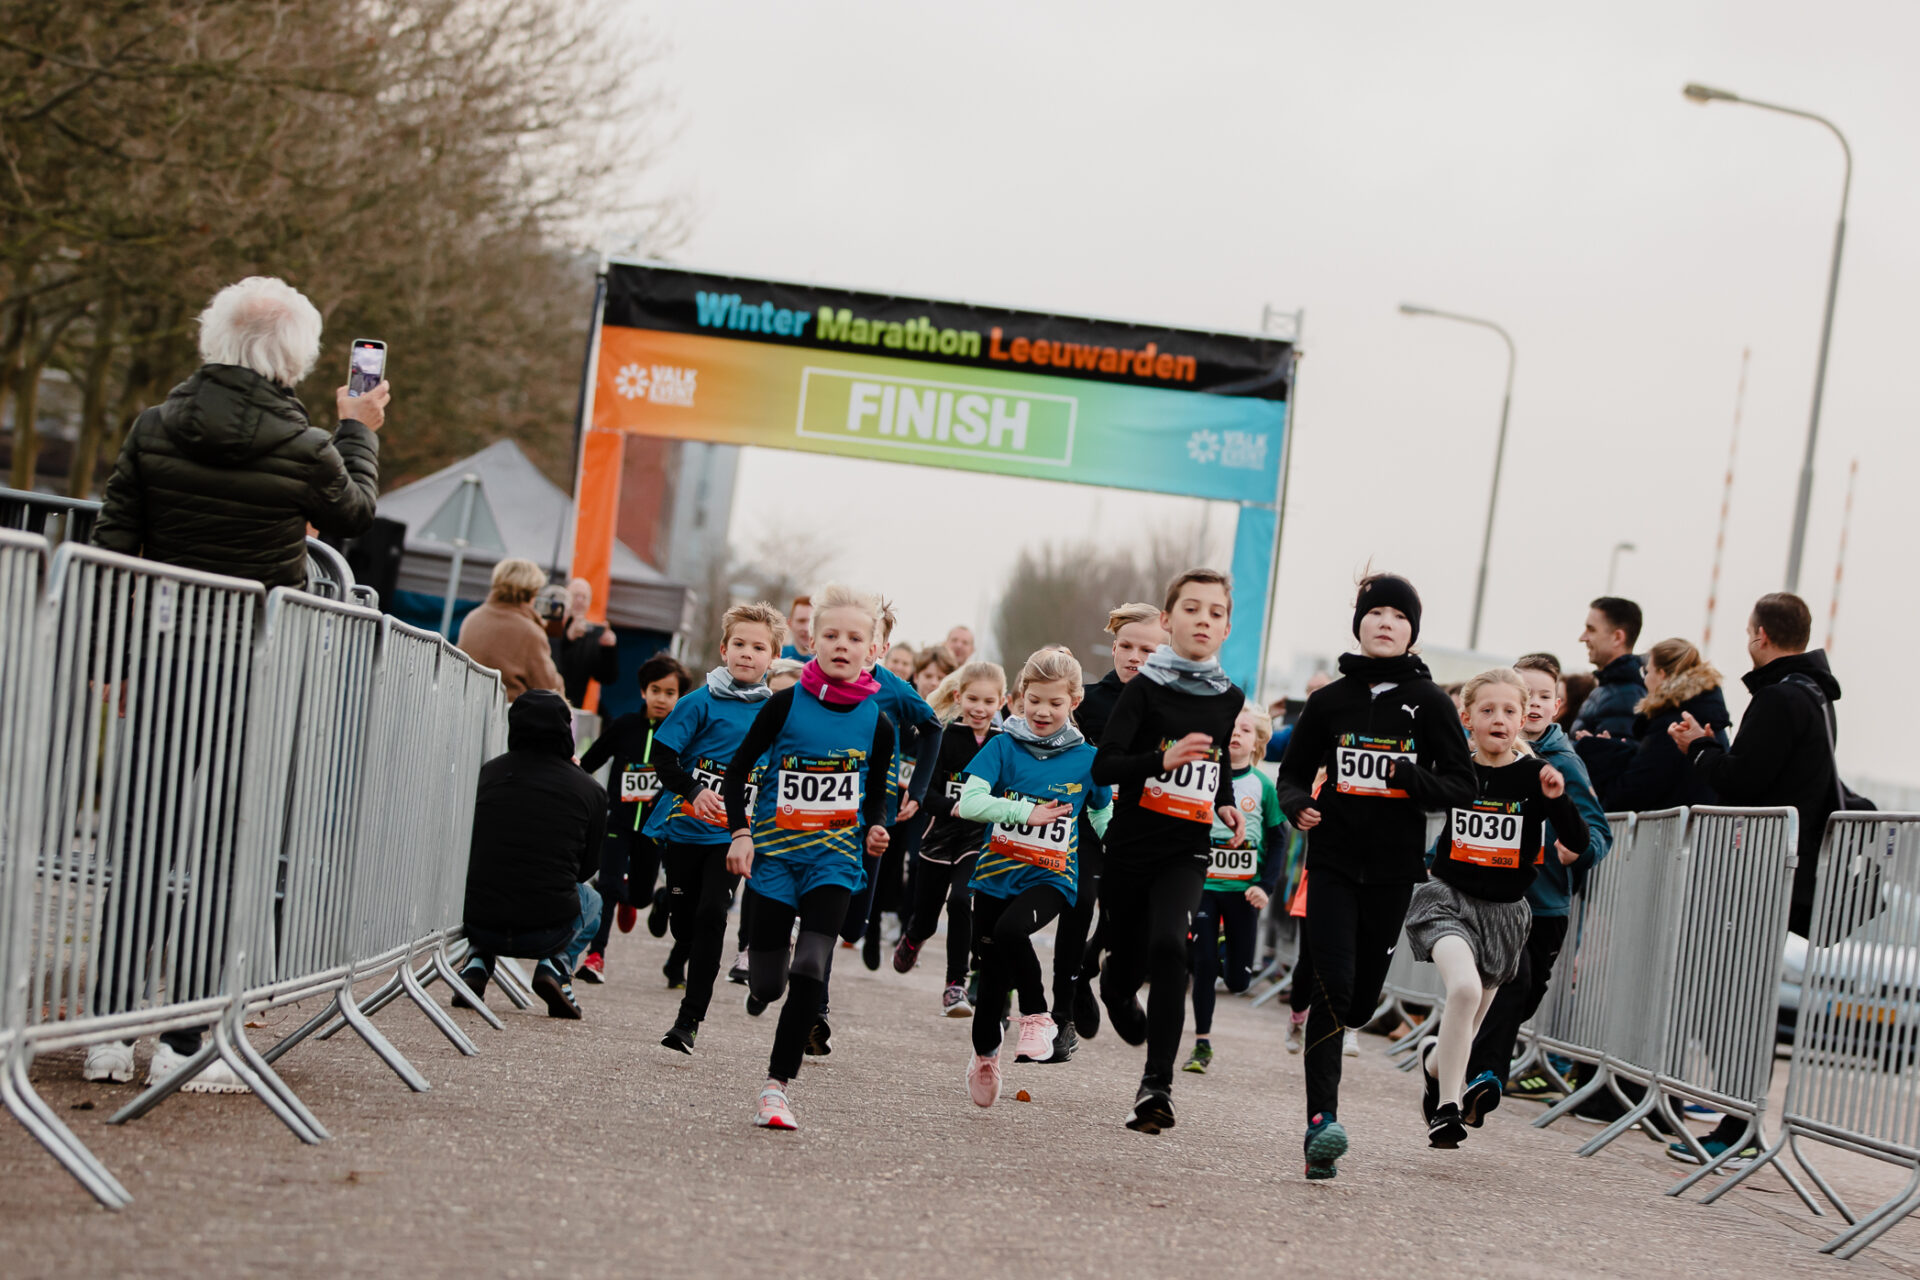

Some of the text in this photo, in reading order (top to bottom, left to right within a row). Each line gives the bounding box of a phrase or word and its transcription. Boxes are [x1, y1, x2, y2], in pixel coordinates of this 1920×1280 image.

[695, 290, 1197, 382] Winter Marathon Leeuwarden
[846, 380, 1030, 451] FINISH
[1341, 750, 1410, 781] 500
[783, 773, 854, 802] 5024
[829, 819, 852, 828] 5024
[1455, 811, 1517, 841] 5030
[1038, 856, 1060, 868] 5015
[1491, 856, 1513, 866] 5030
